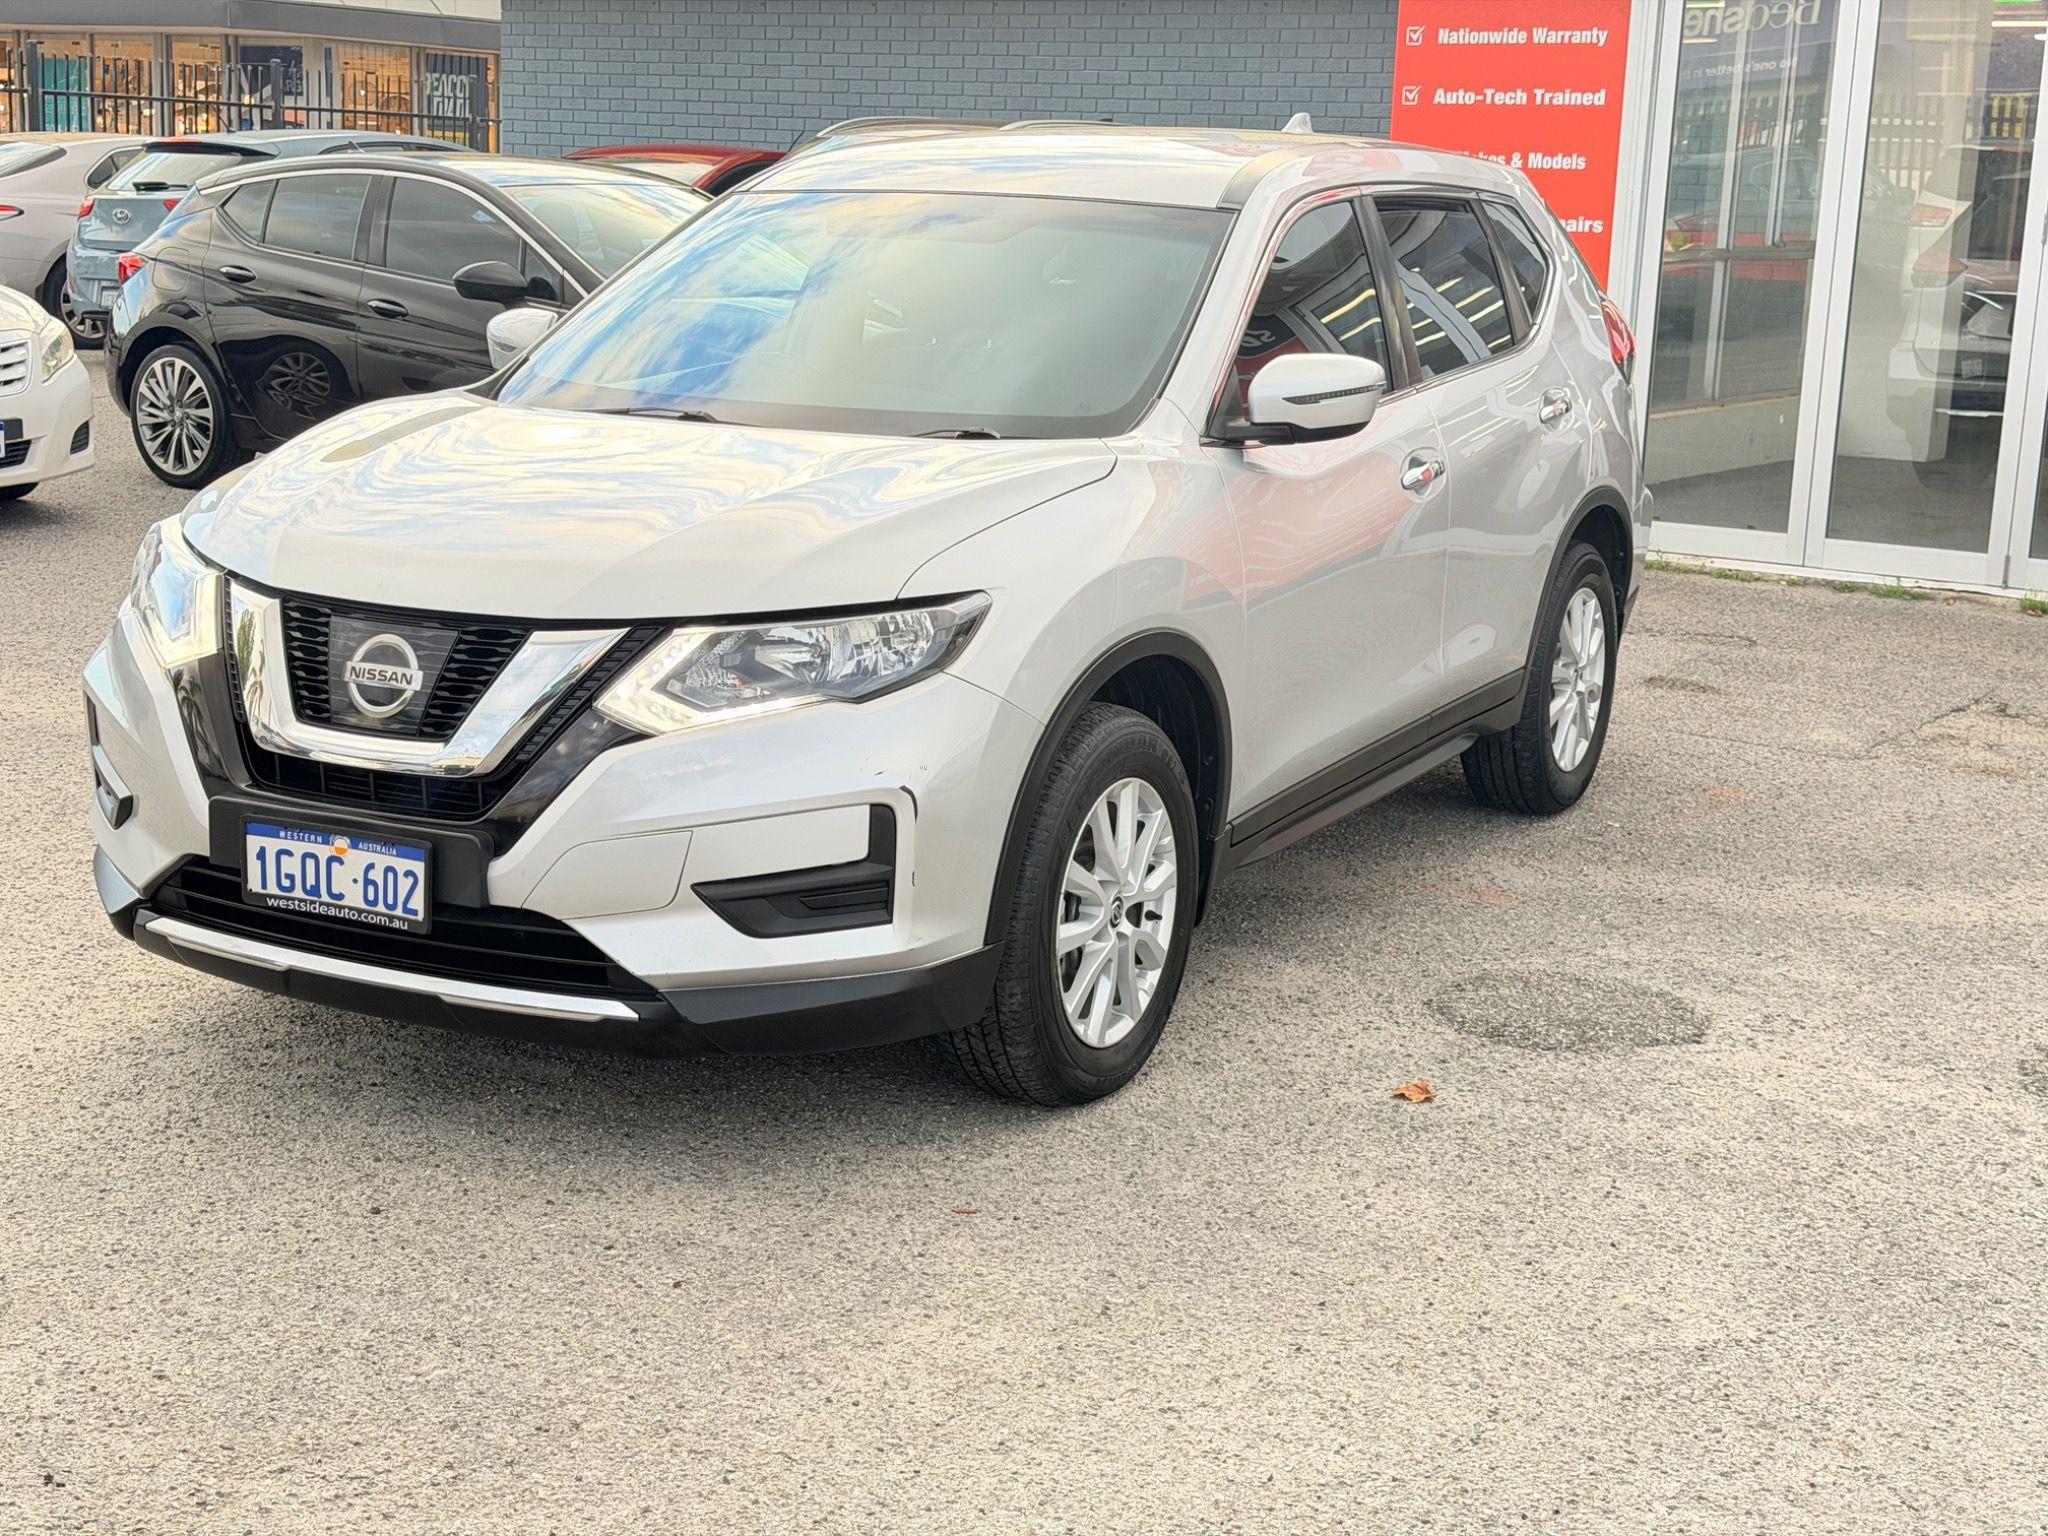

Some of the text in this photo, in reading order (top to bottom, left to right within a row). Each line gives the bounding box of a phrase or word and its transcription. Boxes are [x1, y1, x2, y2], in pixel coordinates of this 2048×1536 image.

[1437, 27, 1608, 47] Nationwide Warranty
[1432, 88, 1607, 106] Auto-Tech Trained
[1510, 151, 1524, 169] &
[1527, 151, 1587, 170] Models
[349, 665, 414, 686] NISSAN
[278, 830, 398, 856] WESTERN AUSTRALIA
[265, 896, 409, 931] westsideauto.com.au
